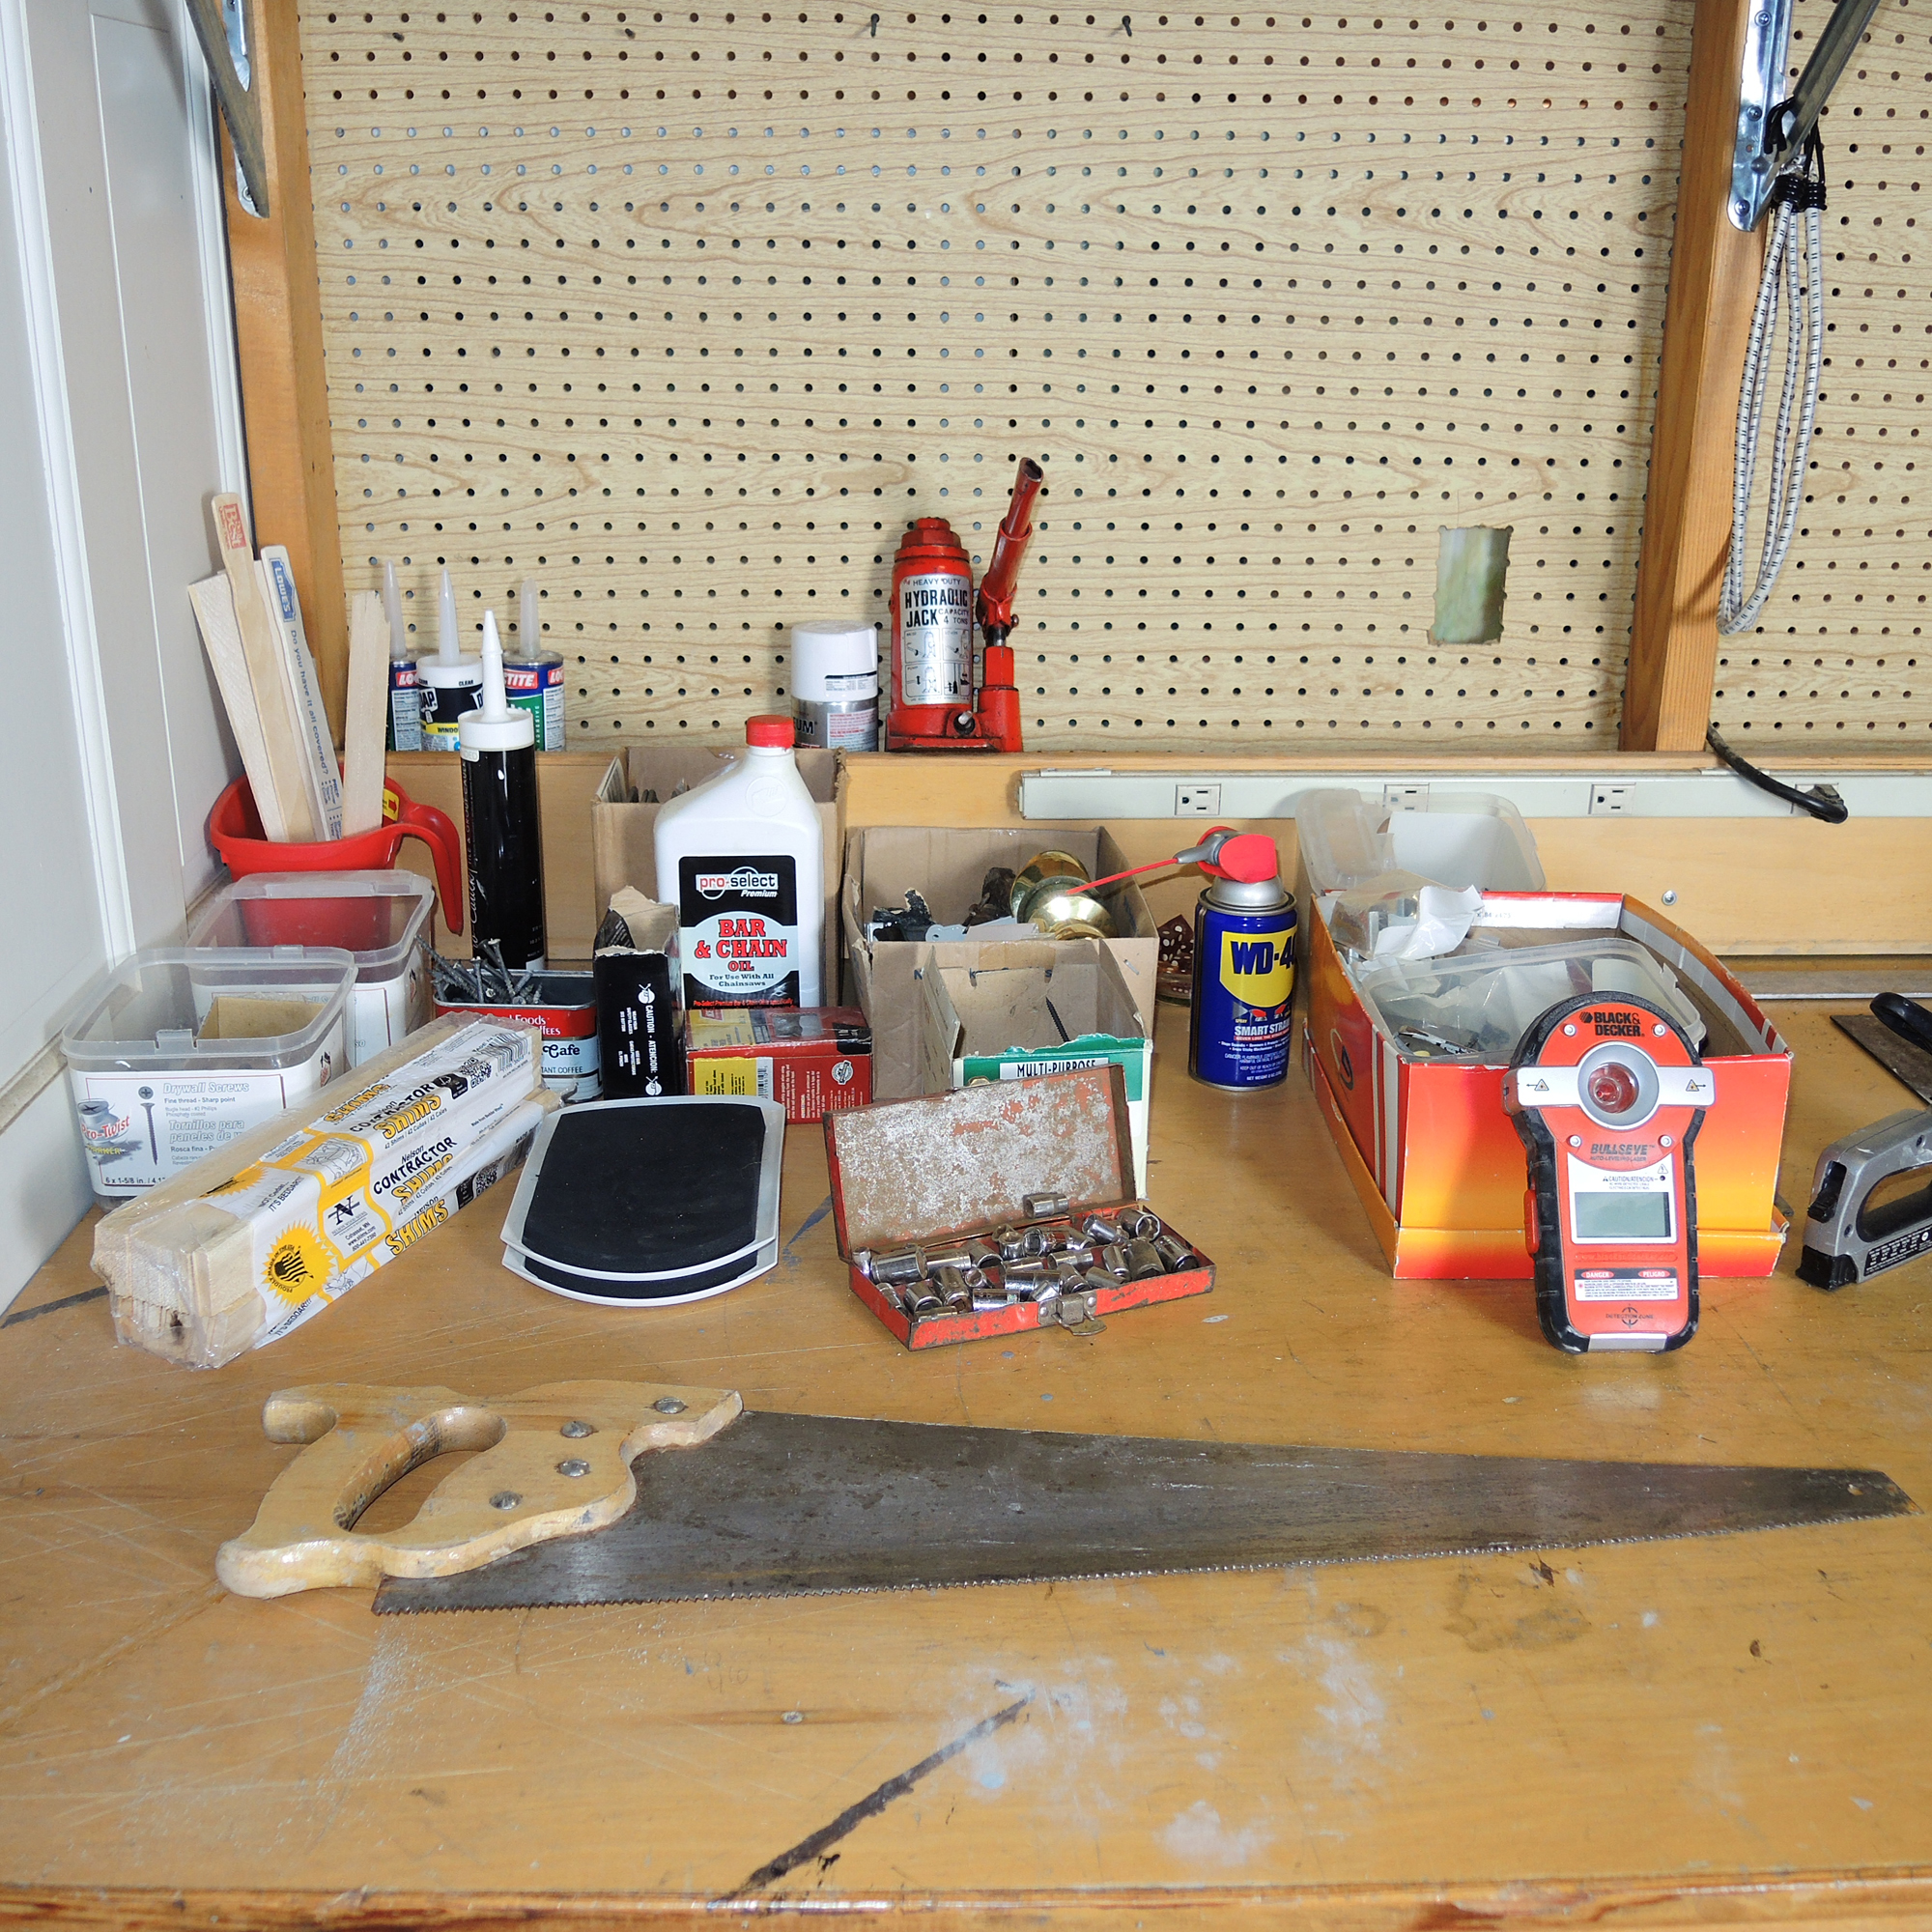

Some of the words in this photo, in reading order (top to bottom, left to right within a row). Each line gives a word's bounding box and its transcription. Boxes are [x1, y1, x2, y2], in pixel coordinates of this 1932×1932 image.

[905, 588, 968, 609] HYDRAULIC
[906, 610, 939, 628] JACK
[943, 615, 950, 624] 4
[952, 616, 968, 625] TONS
[294, 647, 303, 668] you
[300, 670, 310, 696] have
[312, 726, 329, 775] covered?
[699, 872, 776, 890] pro-select
[719, 919, 766, 937] BAR
[695, 940, 711, 958] &
[716, 939, 787, 957] CHAIN
[727, 961, 754, 972] OIL
[515, 1014, 546, 1025] Foods
[645, 1005, 655, 1033] CAUTION
[1235, 1024, 1268, 1036] SMART
[1595, 1025, 1640, 1037] DECKER
[543, 1044, 581, 1059] Cafe
[163, 1082, 206, 1095] Drywall
[209, 1082, 249, 1093] Screws
[374, 1094, 442, 1140] SHIMS
[169, 1120, 216, 1130] Tornillos
[218, 1120, 245, 1131] para
[170, 1131, 213, 1144] paneles
[216, 1130, 232, 1141] de
[391, 1134, 404, 1147] Shims
[402, 1145, 424, 1163] Nelson
[373, 1136, 458, 1195] CONTRACTOR
[269, 1199, 283, 1212] IT'S
[384, 1199, 449, 1256] SHIMS
